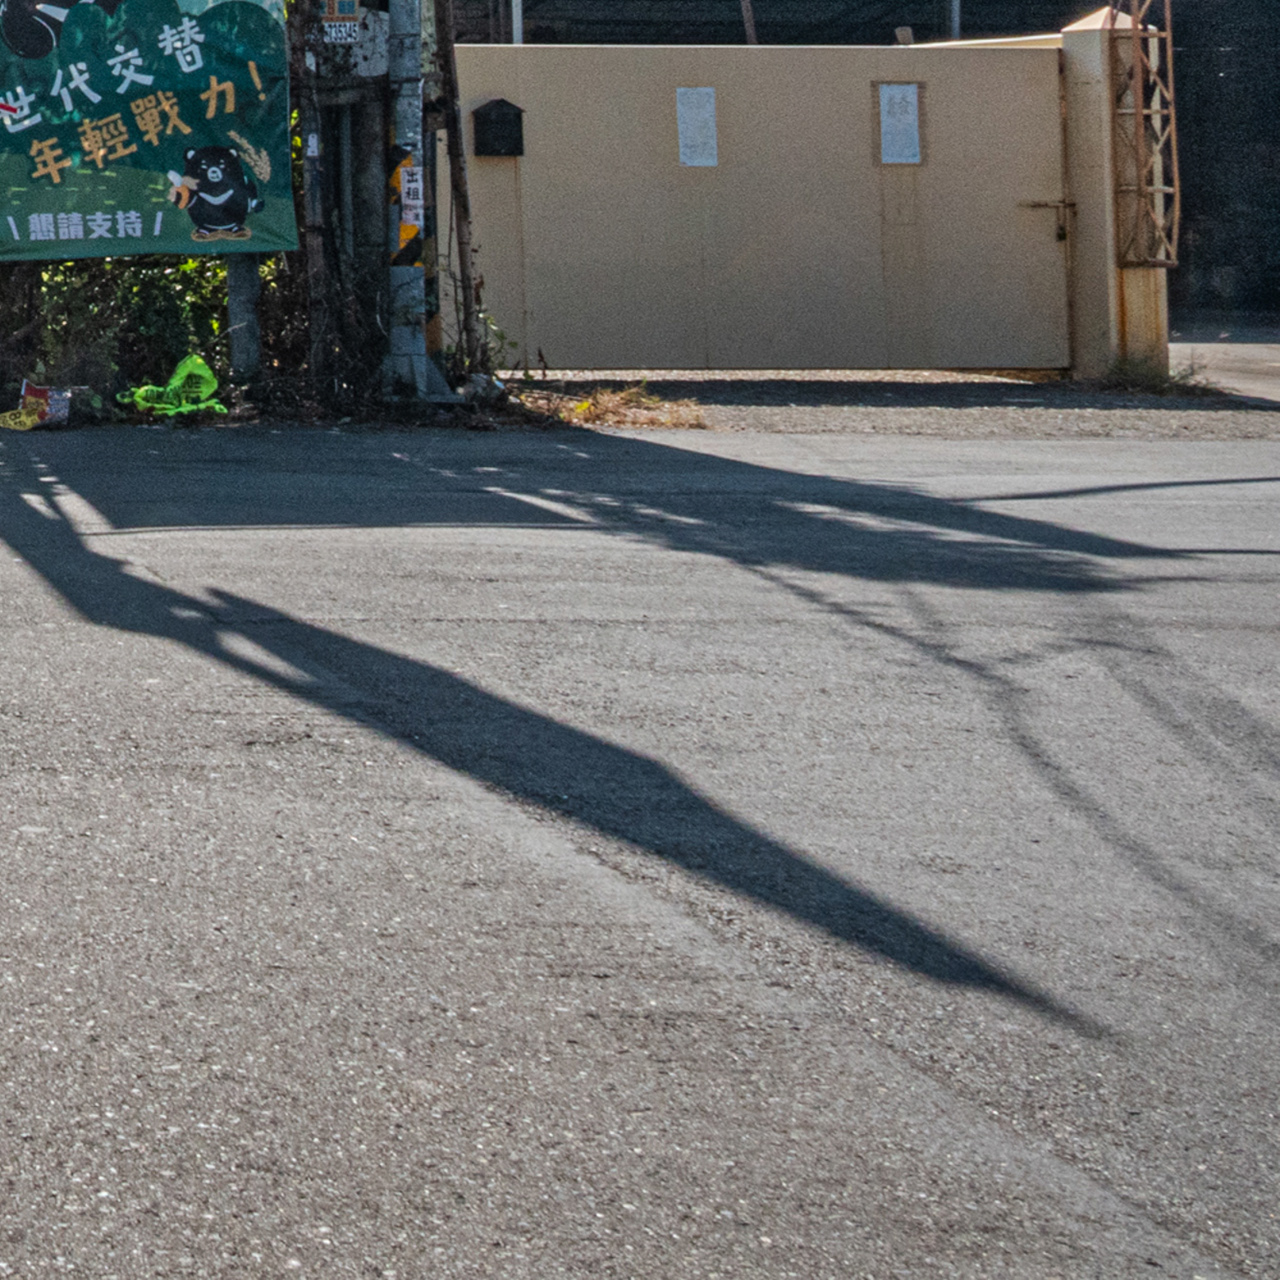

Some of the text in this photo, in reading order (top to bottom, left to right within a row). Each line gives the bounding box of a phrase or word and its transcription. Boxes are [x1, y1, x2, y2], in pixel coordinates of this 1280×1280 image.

[29, 60, 266, 184] 年輕戰力!
[28, 209, 143, 241] 懇請支持
